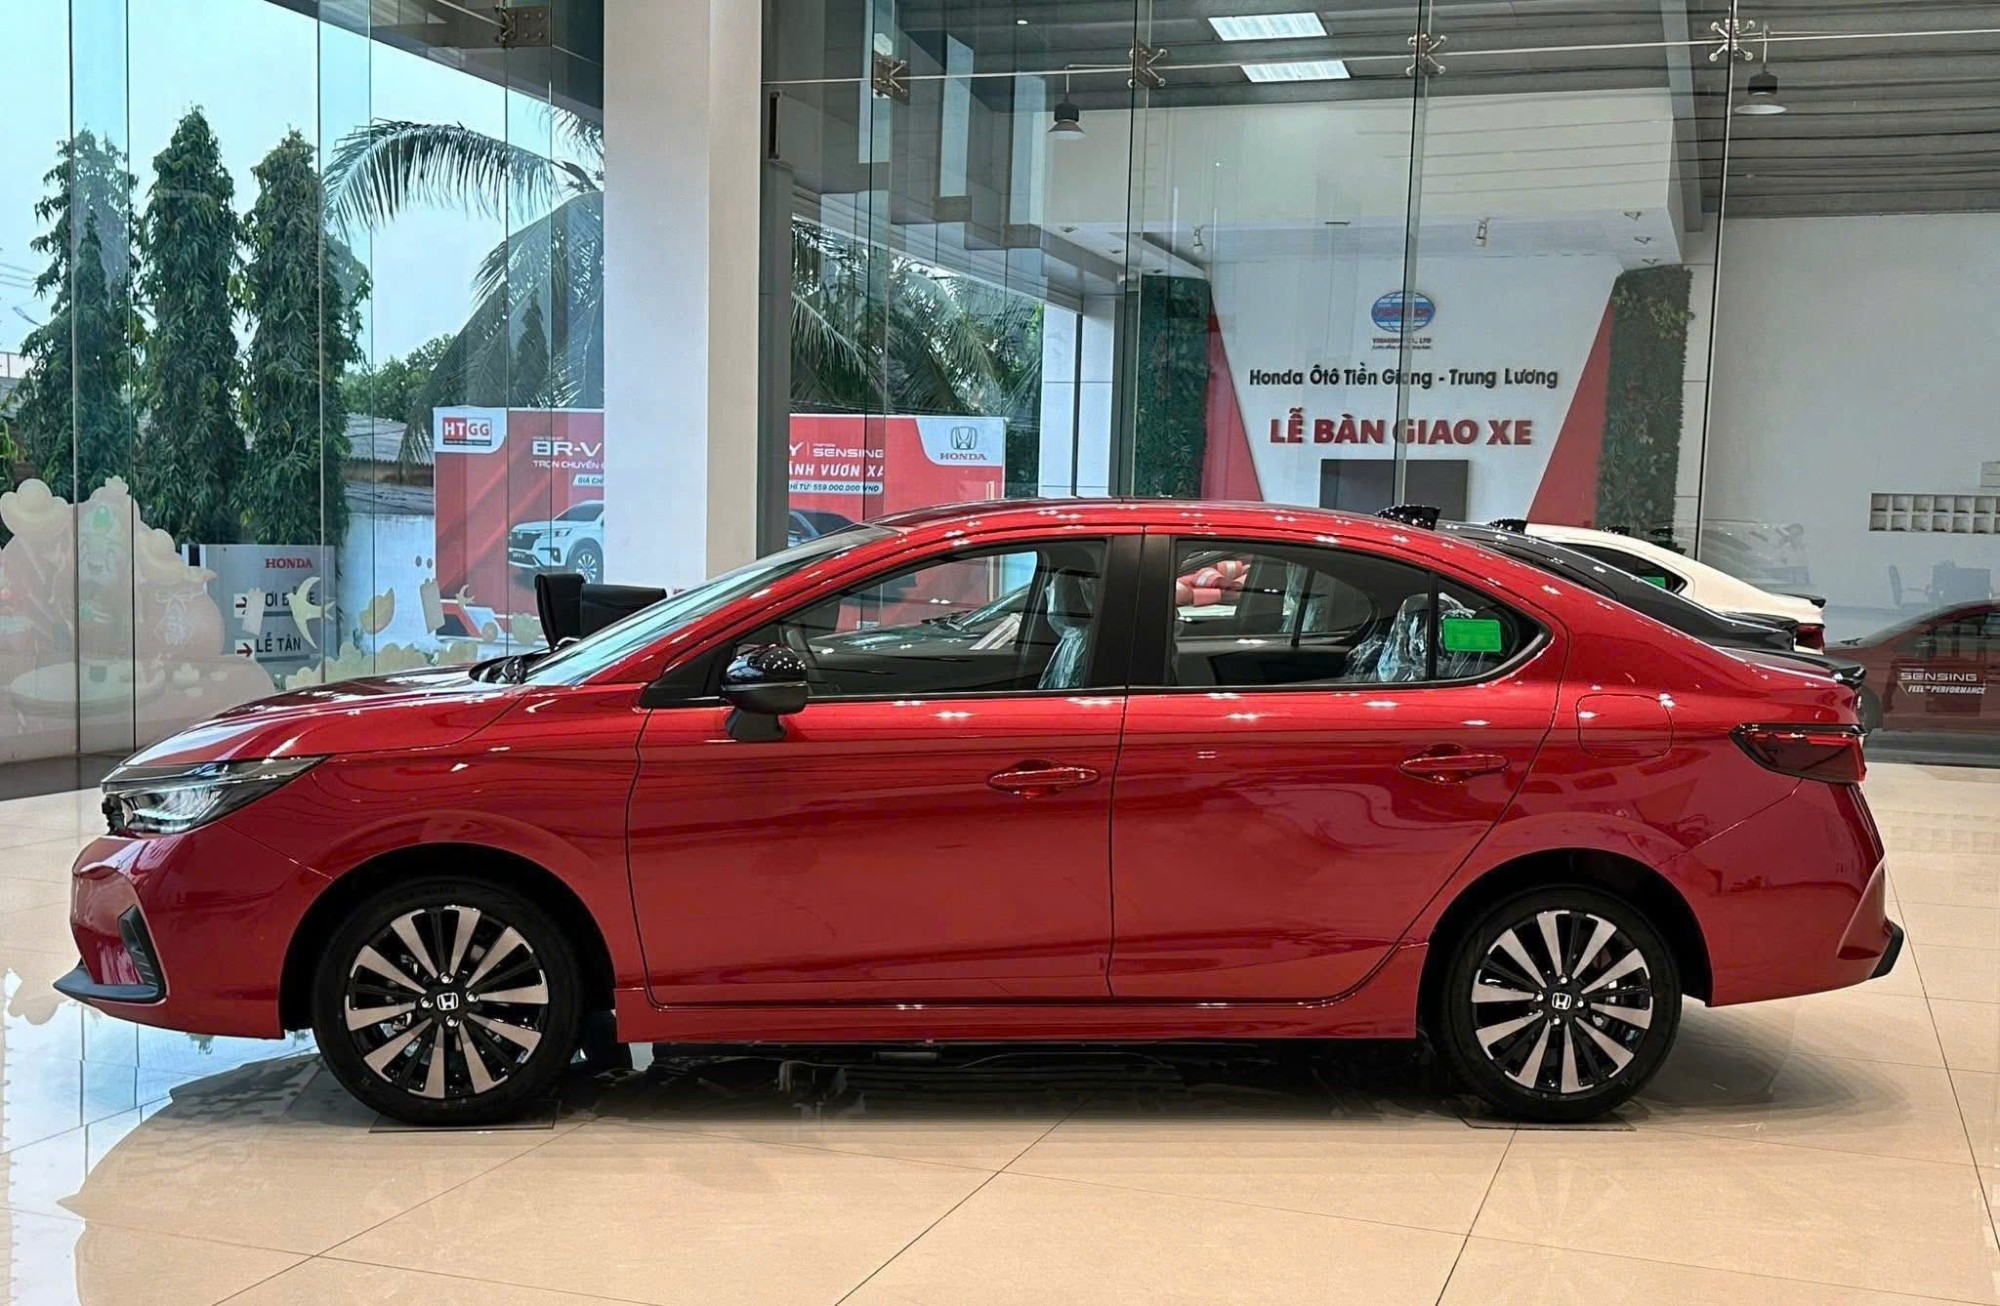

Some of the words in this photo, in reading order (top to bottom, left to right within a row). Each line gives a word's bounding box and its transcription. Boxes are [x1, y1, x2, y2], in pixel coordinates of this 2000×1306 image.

[1250, 369, 1303, 385] Honda
[1310, 364, 1340, 385] Ôtô
[1344, 362, 1377, 385] Tiền
[1449, 369, 1496, 389] Trung
[1505, 368, 1558, 389] Lương
[444, 421, 490, 437] HTGG
[1270, 407, 1303, 444] LỄ
[1314, 413, 1385, 444] BÀN
[1392, 419, 1480, 445] GIAO
[1486, 420, 1532, 445] XE
[532, 441, 602, 457] BR-V
[940, 452, 988, 461] HONDA
[265, 558, 312, 569] HONDA
[276, 633, 301, 652] TÂN
[1900, 671, 1978, 682] SENSING
